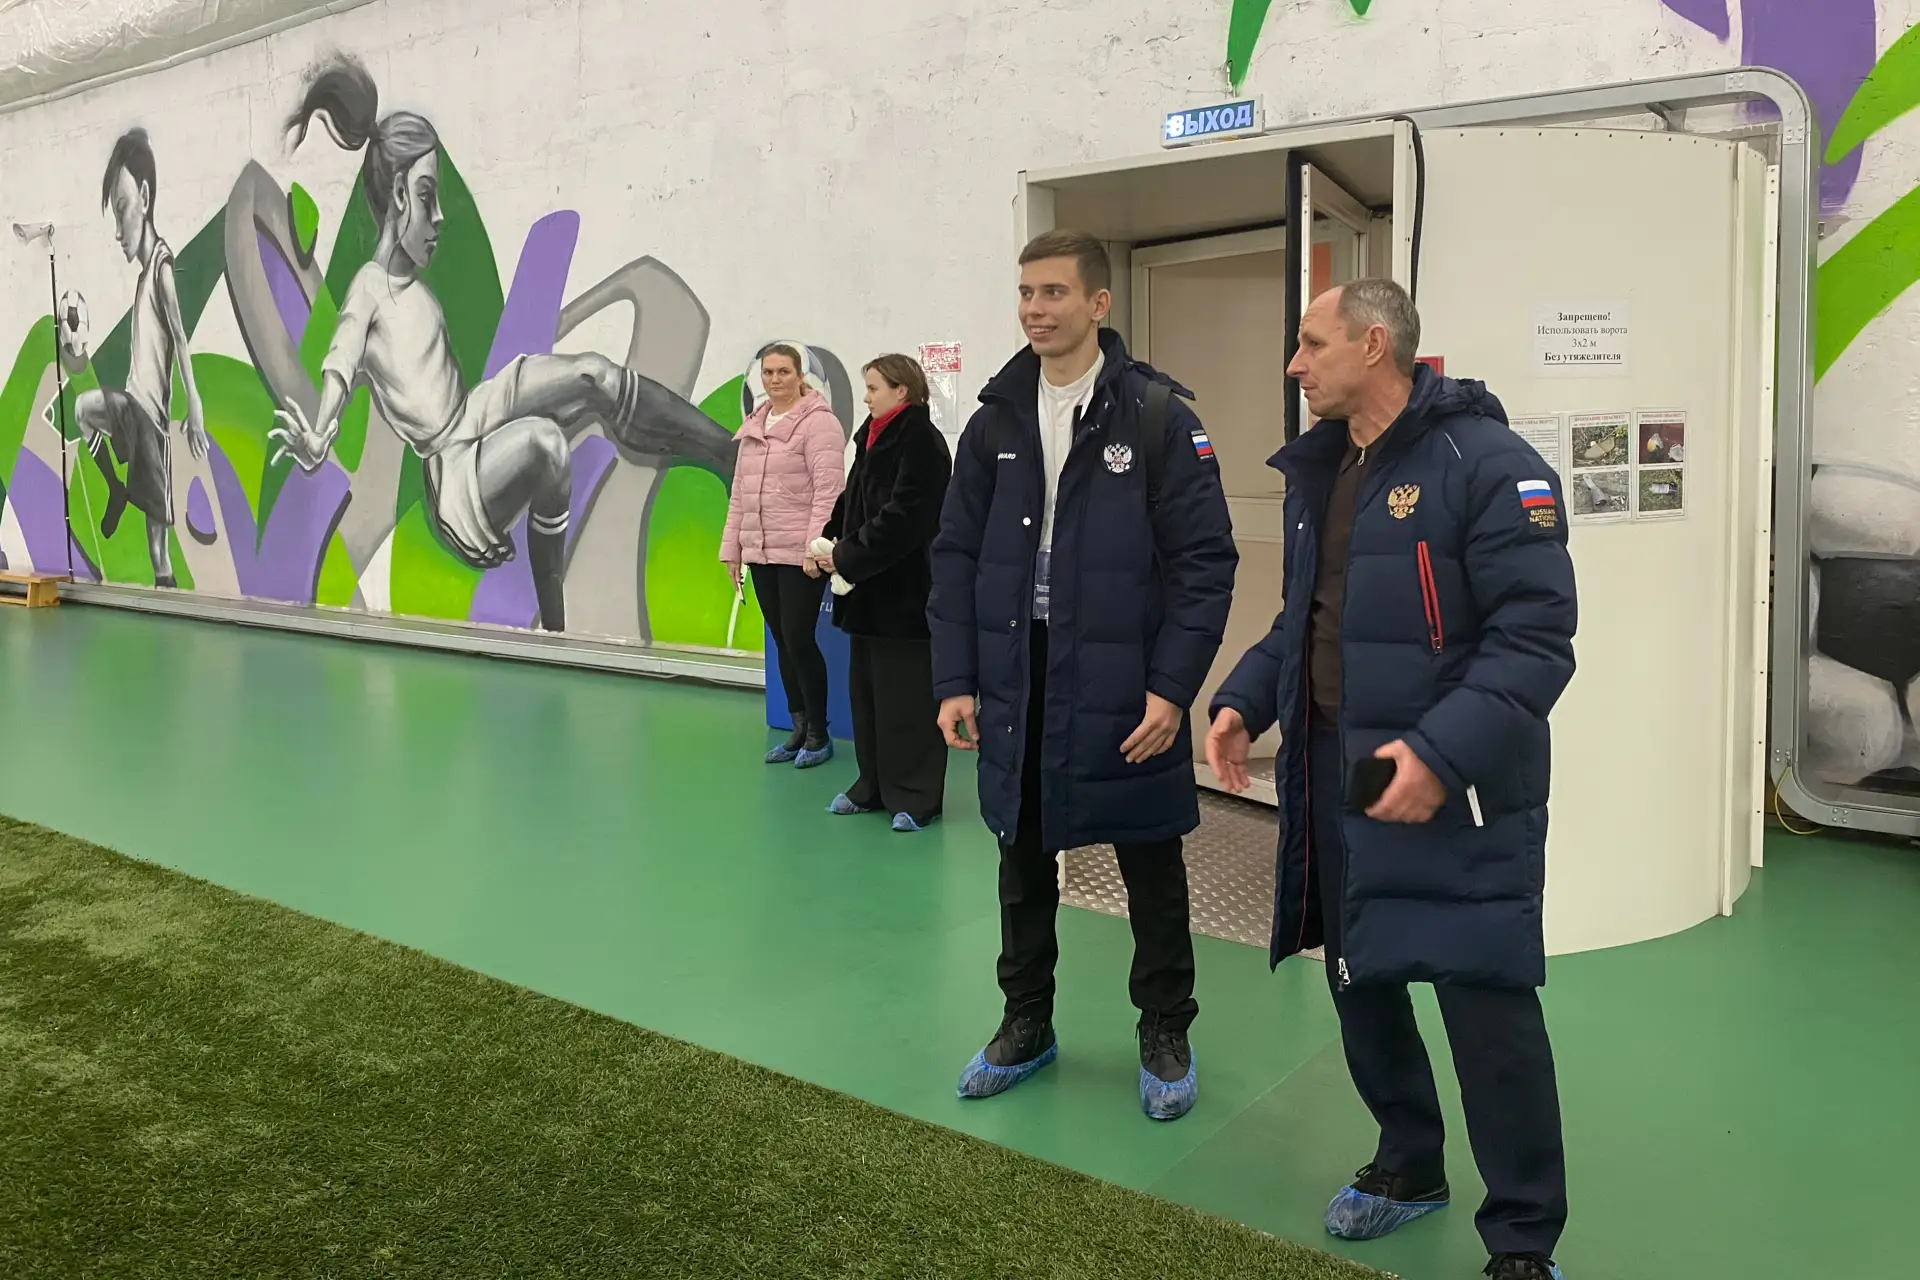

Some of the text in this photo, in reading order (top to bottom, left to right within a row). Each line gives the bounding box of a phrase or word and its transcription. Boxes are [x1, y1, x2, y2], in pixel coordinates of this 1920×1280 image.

[1169, 105, 1251, 137] ВЫХОД
[1557, 312, 1611, 323] Запрещено!
[1537, 325, 1628, 336] Использовать ворота
[1590, 340, 1597, 348] м
[1544, 352, 1621, 363] Без утяжелителя
[1530, 508, 1556, 516] RUSSIAN
